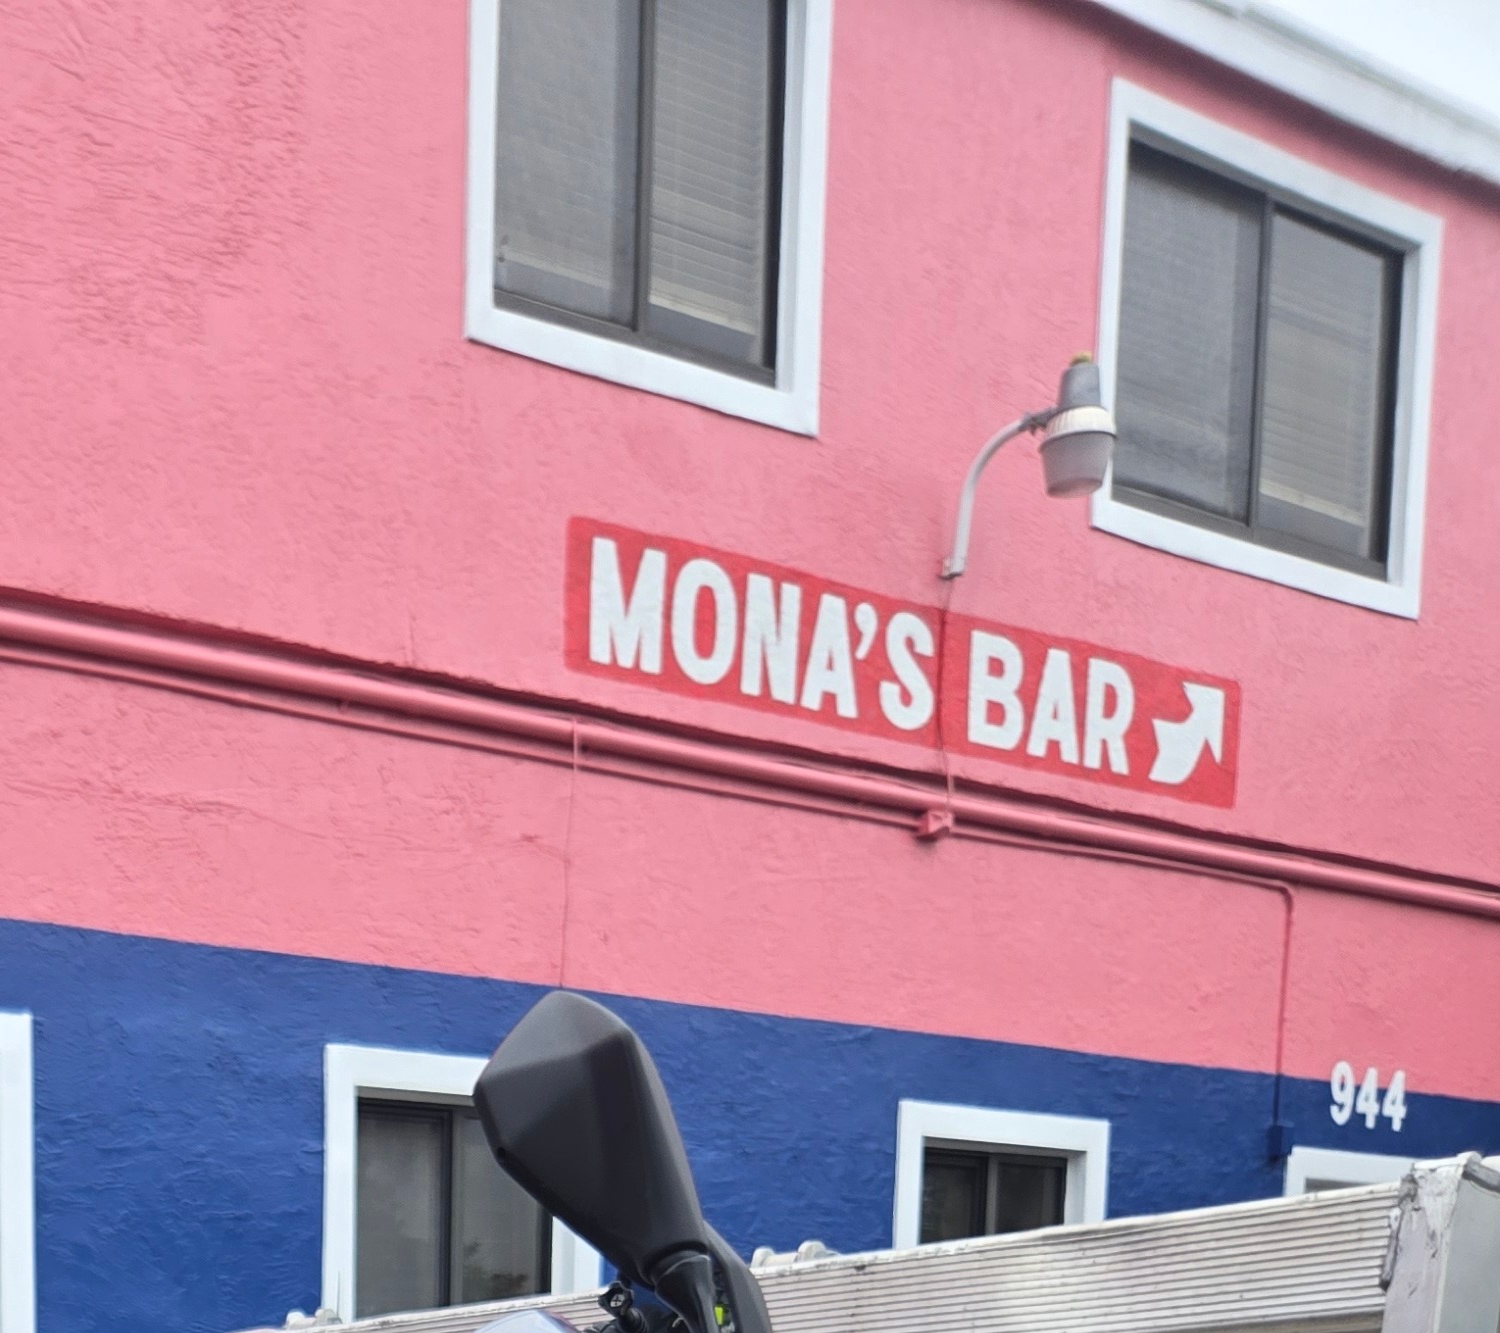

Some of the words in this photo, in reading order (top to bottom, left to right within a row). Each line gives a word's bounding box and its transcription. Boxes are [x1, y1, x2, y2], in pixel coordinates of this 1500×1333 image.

[590, 536, 934, 730] MONA'S
[968, 629, 1135, 775] BAR
[1330, 1060, 1407, 1132] 944
